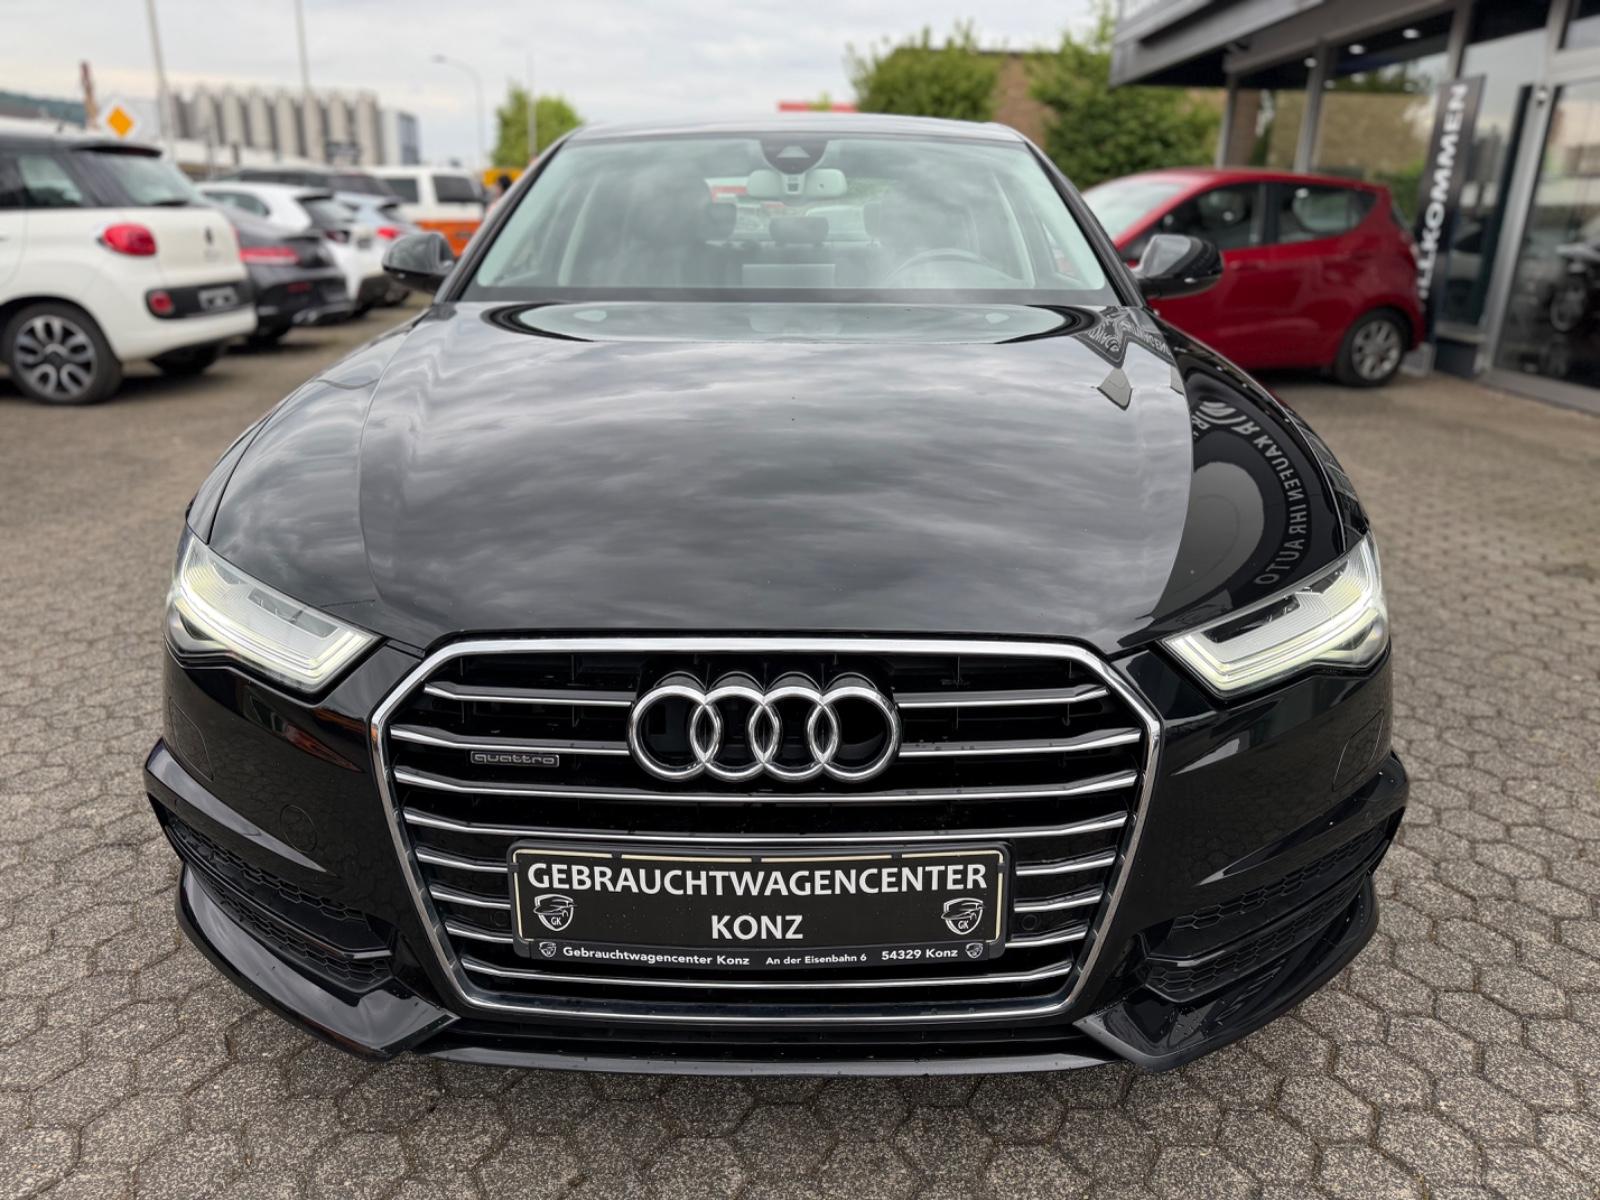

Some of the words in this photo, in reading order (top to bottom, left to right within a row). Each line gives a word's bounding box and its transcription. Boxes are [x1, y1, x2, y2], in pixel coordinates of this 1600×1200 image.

[1416, 83, 1468, 306] ILLKOMMEN
[474, 753, 555, 765] quattro
[527, 863, 988, 897] GEBRAUCHTWAGENCENTER
[550, 916, 562, 926] GK
[711, 914, 804, 940] KONZ
[562, 946, 713, 965] Gebrauchtwagencenter
[716, 955, 750, 965] Konz
[765, 957, 781, 965] An
[783, 955, 802, 965] der
[804, 954, 857, 964] Eisenbahn
[860, 953, 867, 961] 6
[881, 949, 922, 960] 54329
[925, 948, 959, 958] Konz
